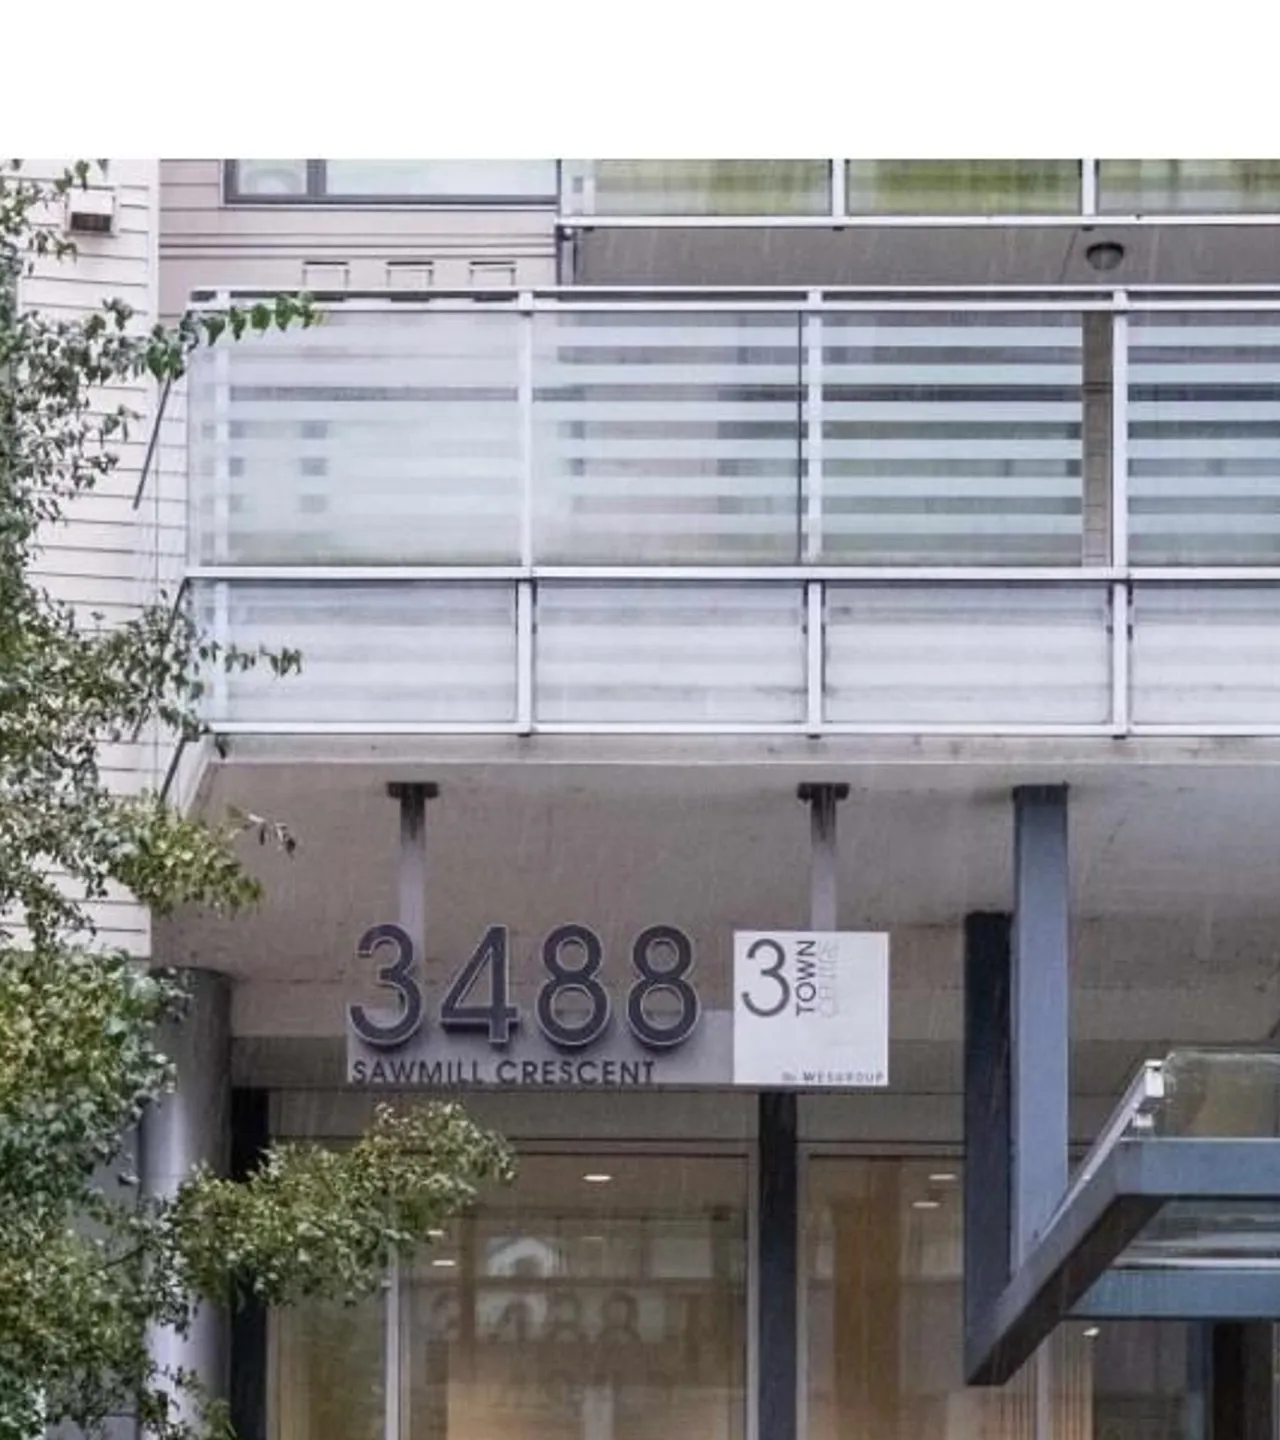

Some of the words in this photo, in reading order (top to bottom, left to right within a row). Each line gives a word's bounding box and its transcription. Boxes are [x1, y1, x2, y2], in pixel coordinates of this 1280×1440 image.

[349, 923, 700, 1047] 3488
[741, 938, 790, 1018] 3
[795, 940, 816, 1018] TOWN
[351, 1060, 483, 1085] SAWMILL
[496, 1060, 656, 1085] CRESCENT
